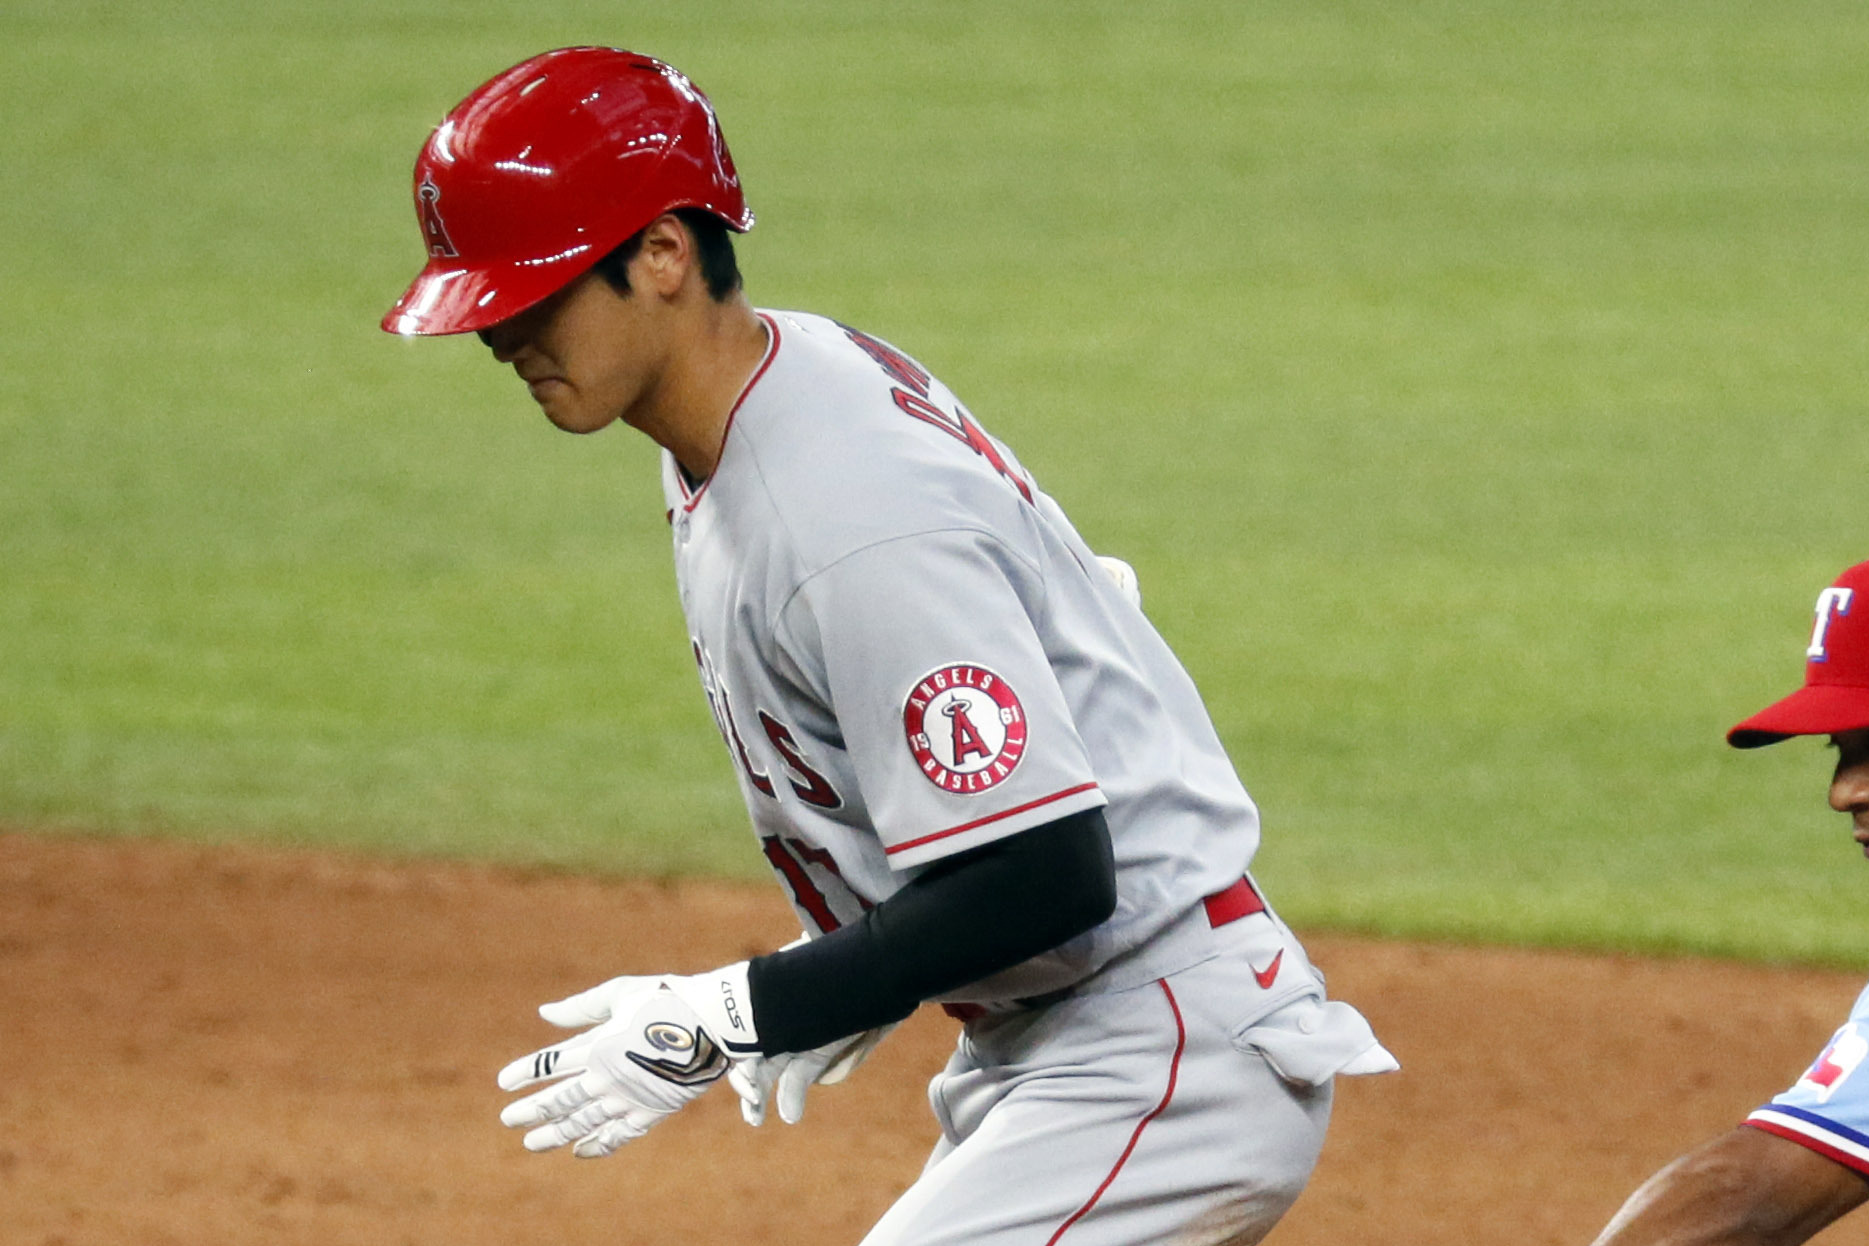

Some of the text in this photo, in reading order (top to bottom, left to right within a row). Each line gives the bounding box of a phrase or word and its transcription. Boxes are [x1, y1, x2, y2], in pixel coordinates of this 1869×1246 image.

[1806, 586, 1854, 663] T
[911, 667, 994, 712] ANGELS
[944, 696, 993, 768] A
[922, 738, 1024, 790] BASEBALL
